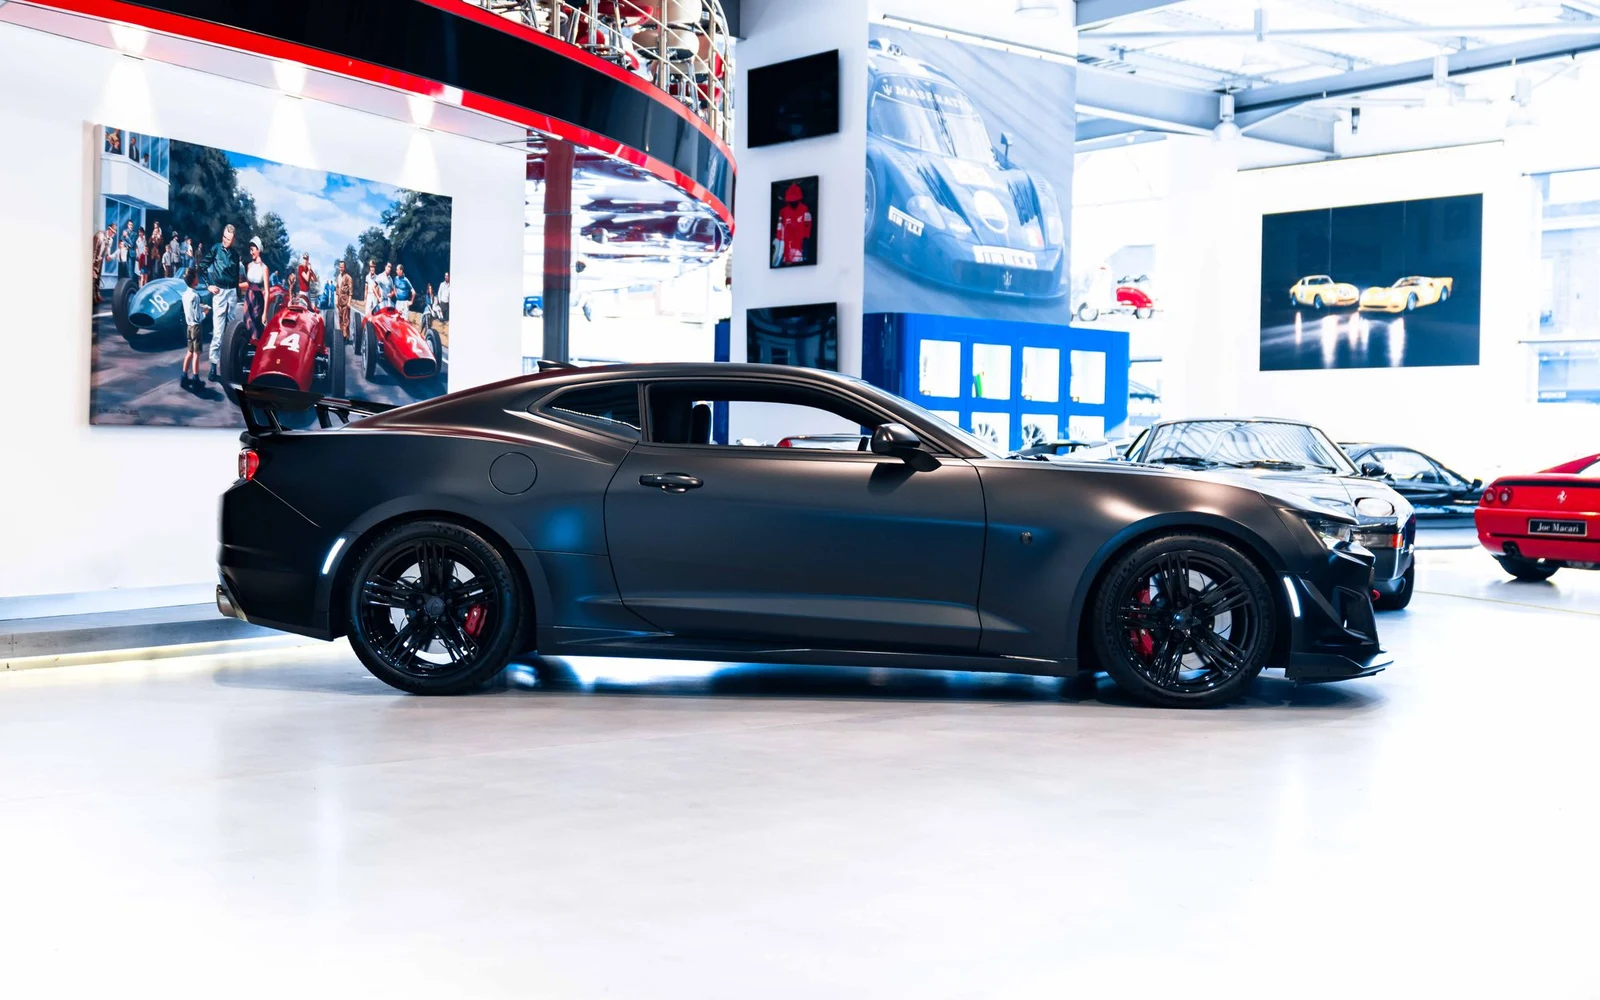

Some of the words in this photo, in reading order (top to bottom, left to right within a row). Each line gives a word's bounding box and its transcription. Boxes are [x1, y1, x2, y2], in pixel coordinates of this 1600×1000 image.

[148, 294, 169, 313] 18
[262, 331, 300, 353] 14
[1537, 522, 1550, 531] Joe
[1552, 522, 1579, 532] Macari
